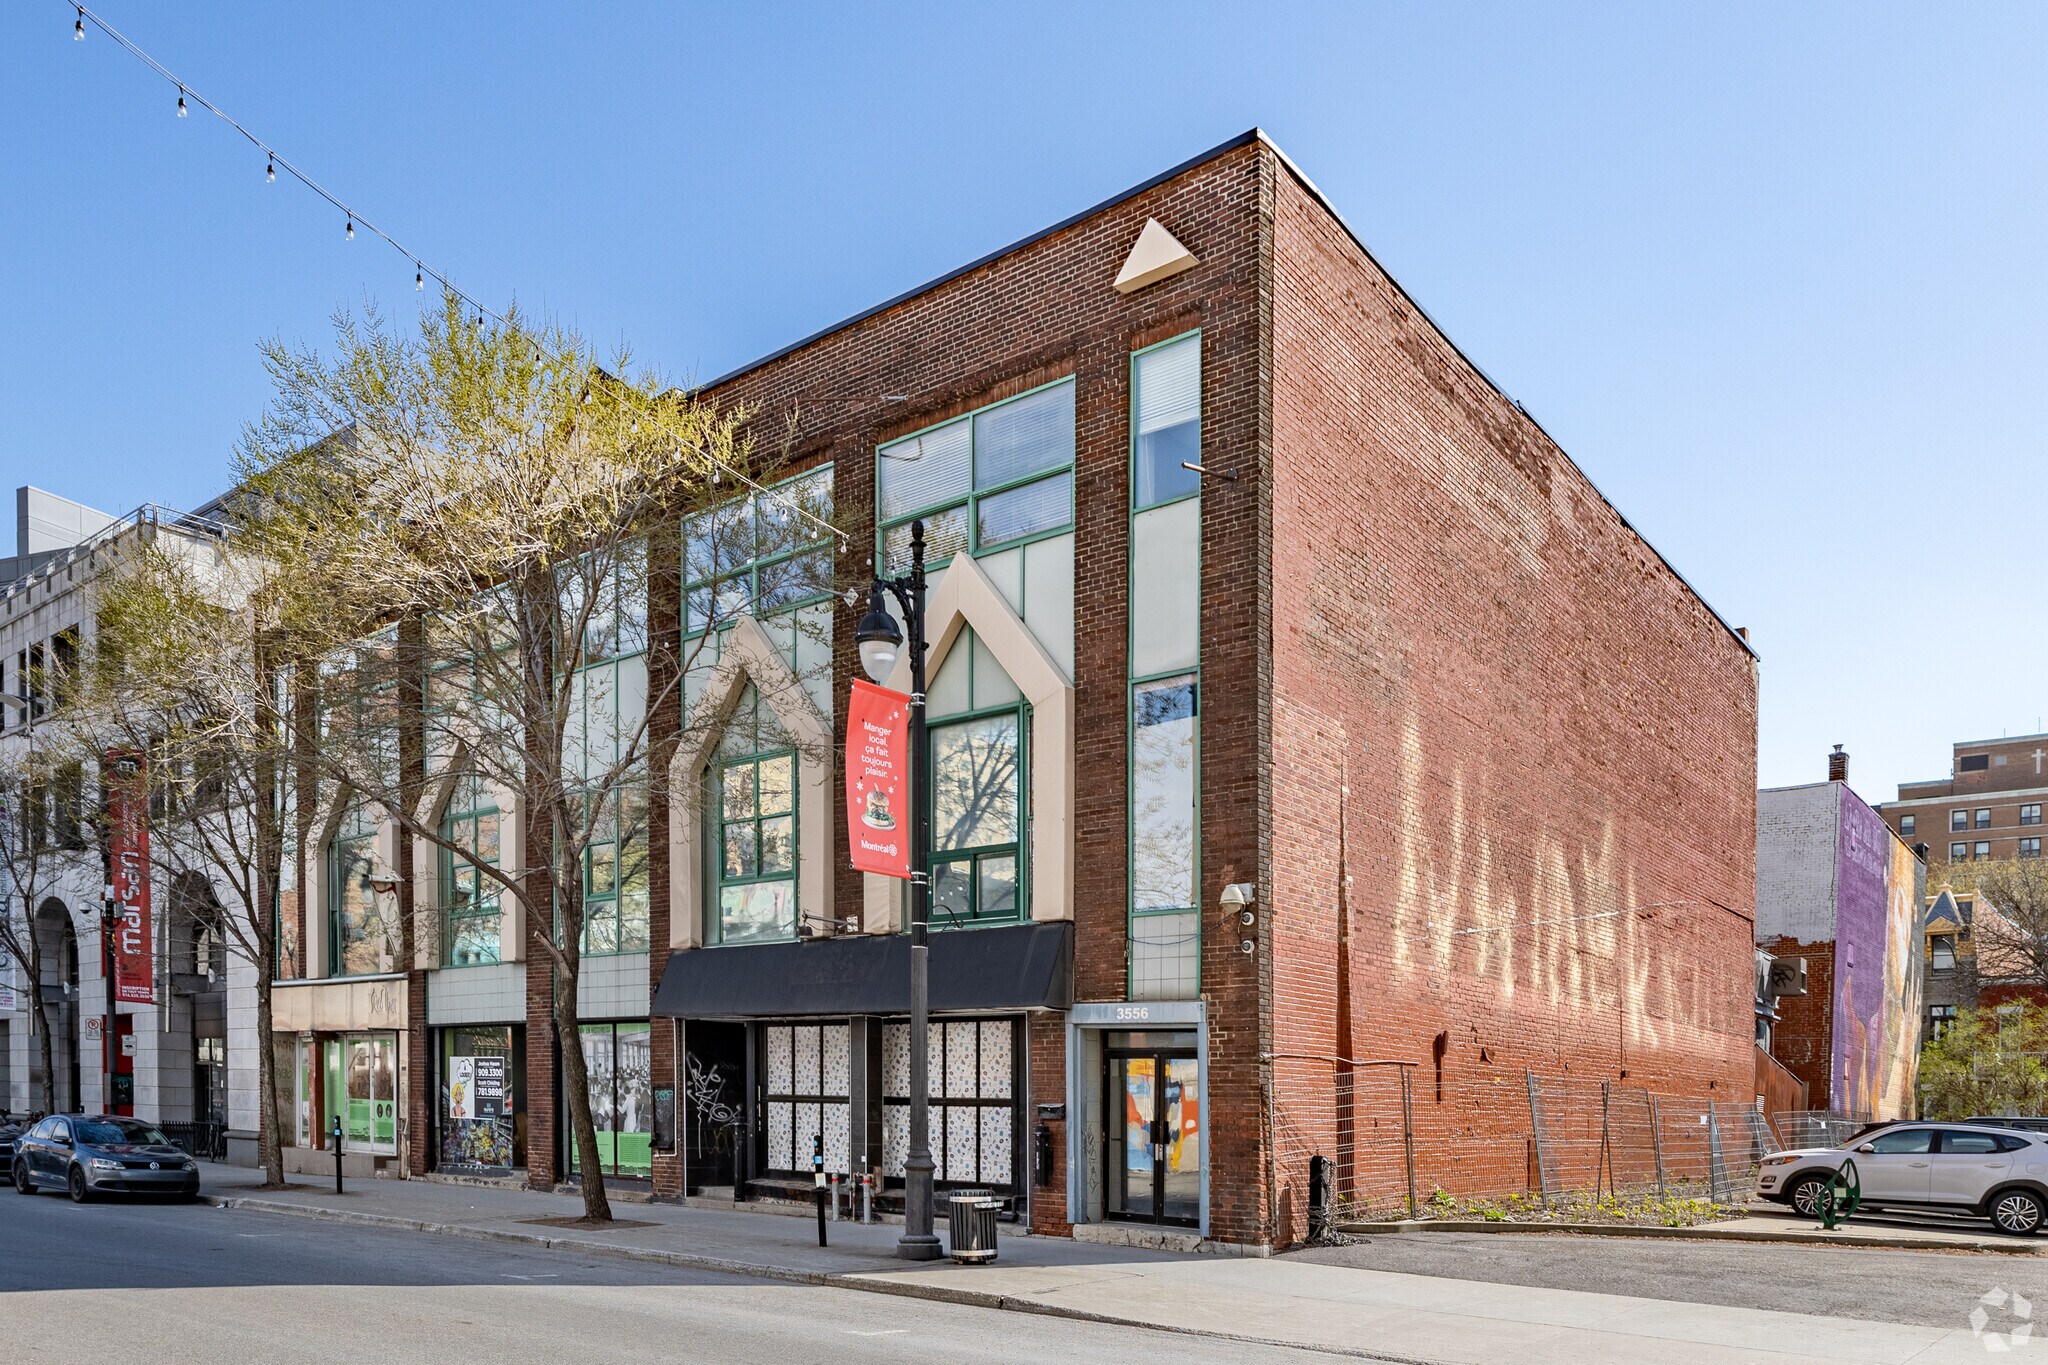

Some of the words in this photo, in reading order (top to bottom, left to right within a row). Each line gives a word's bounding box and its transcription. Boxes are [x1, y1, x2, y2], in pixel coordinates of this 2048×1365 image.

[864, 721, 892, 736] Manger
[869, 734, 888, 747] local,
[865, 745, 875, 754] ça
[876, 746, 889, 757] fait
[861, 754, 892, 768] toujours
[865, 767, 888, 779] plaisir.
[861, 839, 891, 854] Montréal
[1116, 1007, 1149, 1020] 3556
[477, 1068, 503, 1078] 909.3300
